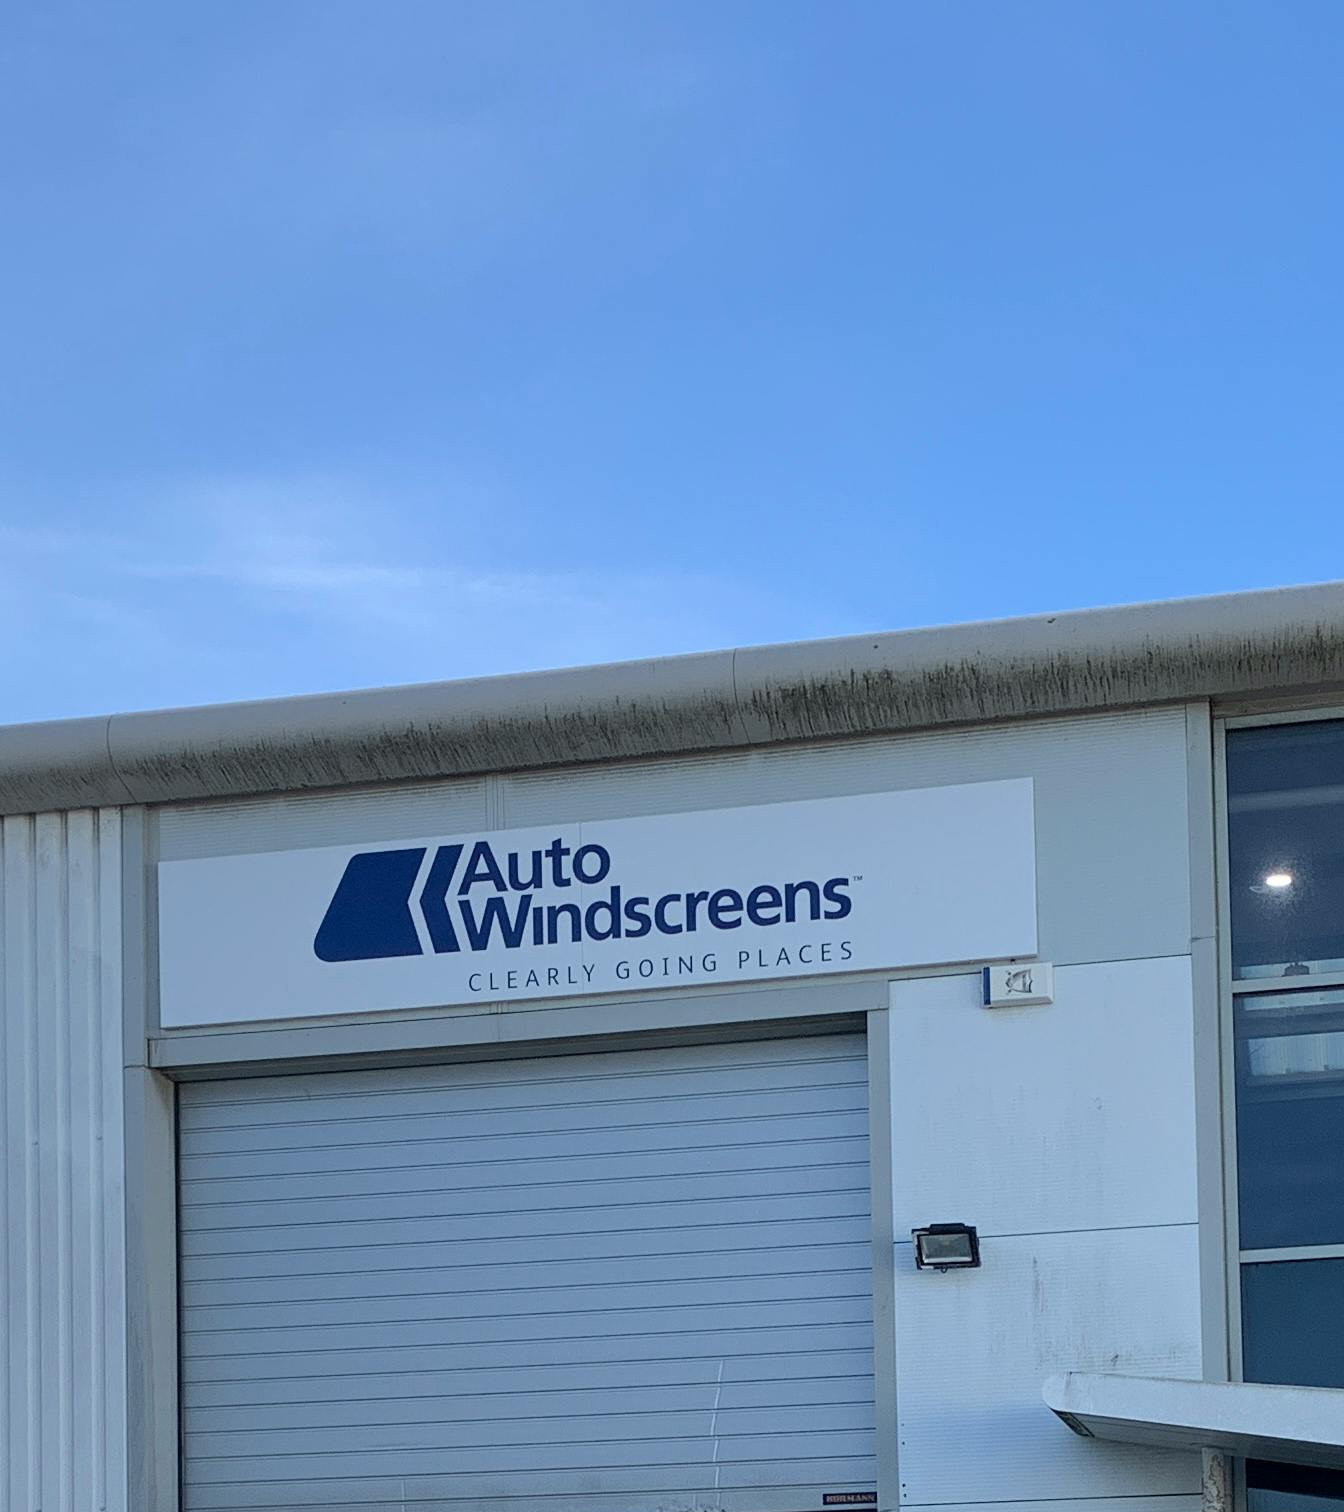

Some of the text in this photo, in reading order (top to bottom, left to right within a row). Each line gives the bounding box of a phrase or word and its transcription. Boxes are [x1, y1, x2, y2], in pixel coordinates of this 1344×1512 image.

[458, 838, 611, 896] Auto
[468, 940, 854, 993] CLEARLY GOING PLACES
